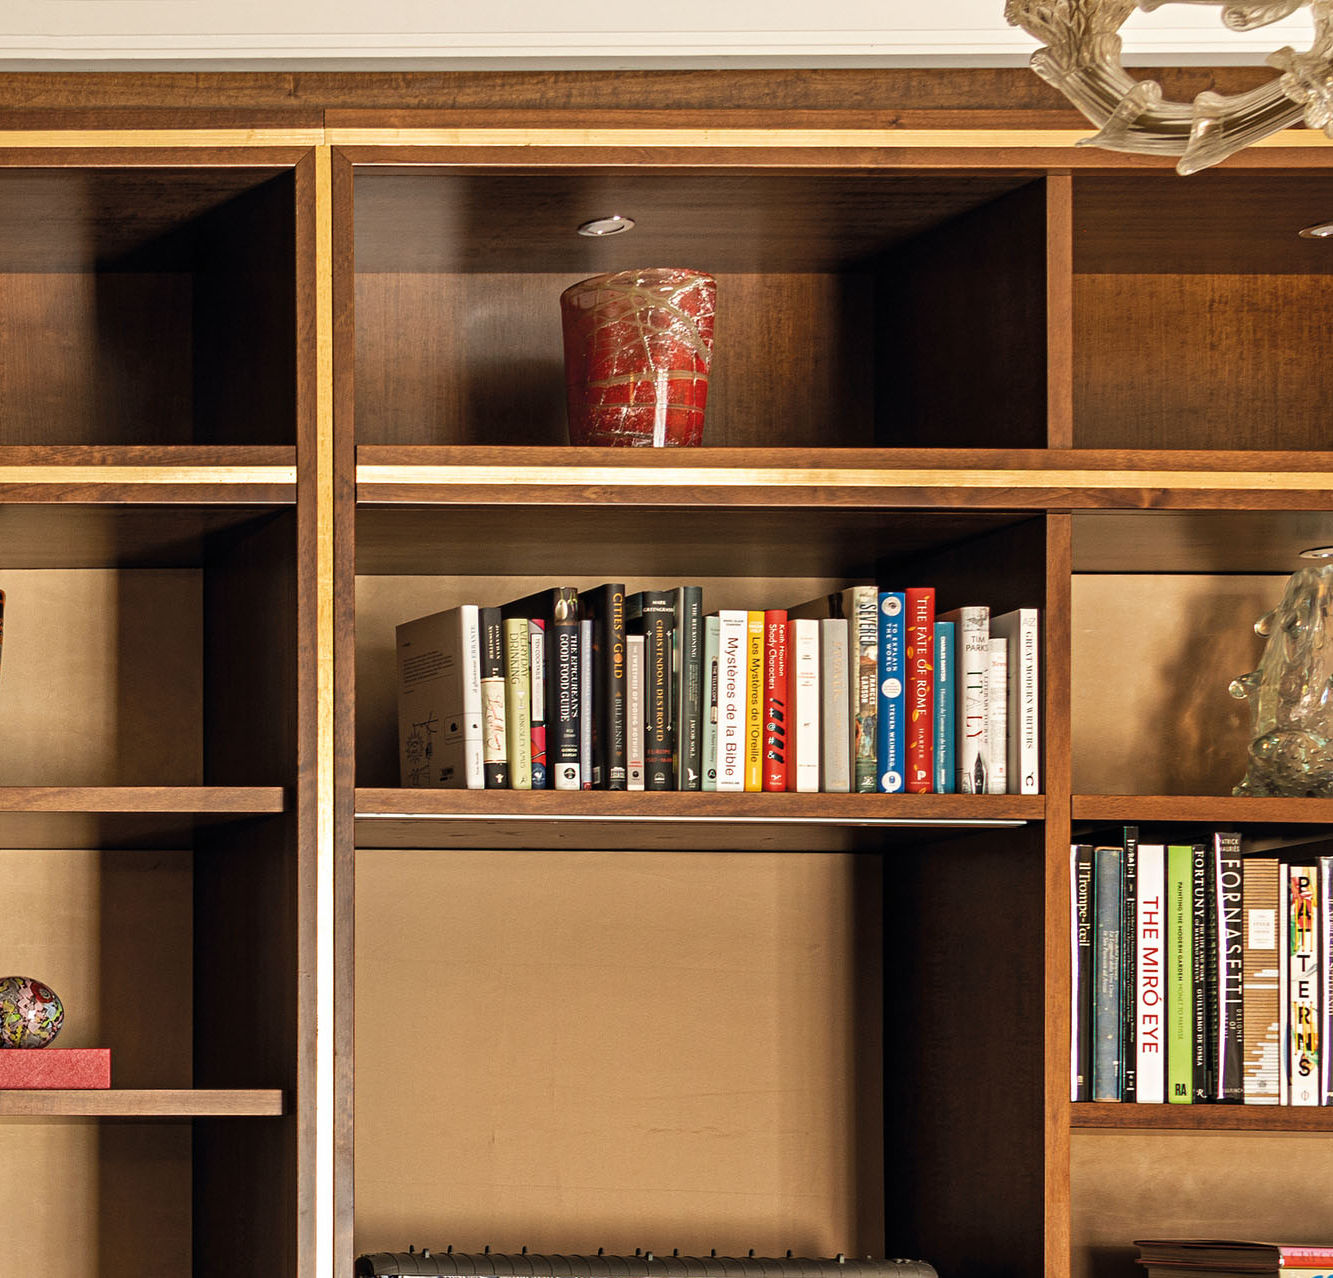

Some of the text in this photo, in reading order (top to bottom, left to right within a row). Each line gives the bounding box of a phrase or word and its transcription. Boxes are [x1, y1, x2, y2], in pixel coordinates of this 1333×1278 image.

[725, 637, 738, 776] Mystères de la Bible
[917, 600, 927, 715] THE FATE OF ROME
[1143, 896, 1162, 1053] THE MIRÓ EYE
